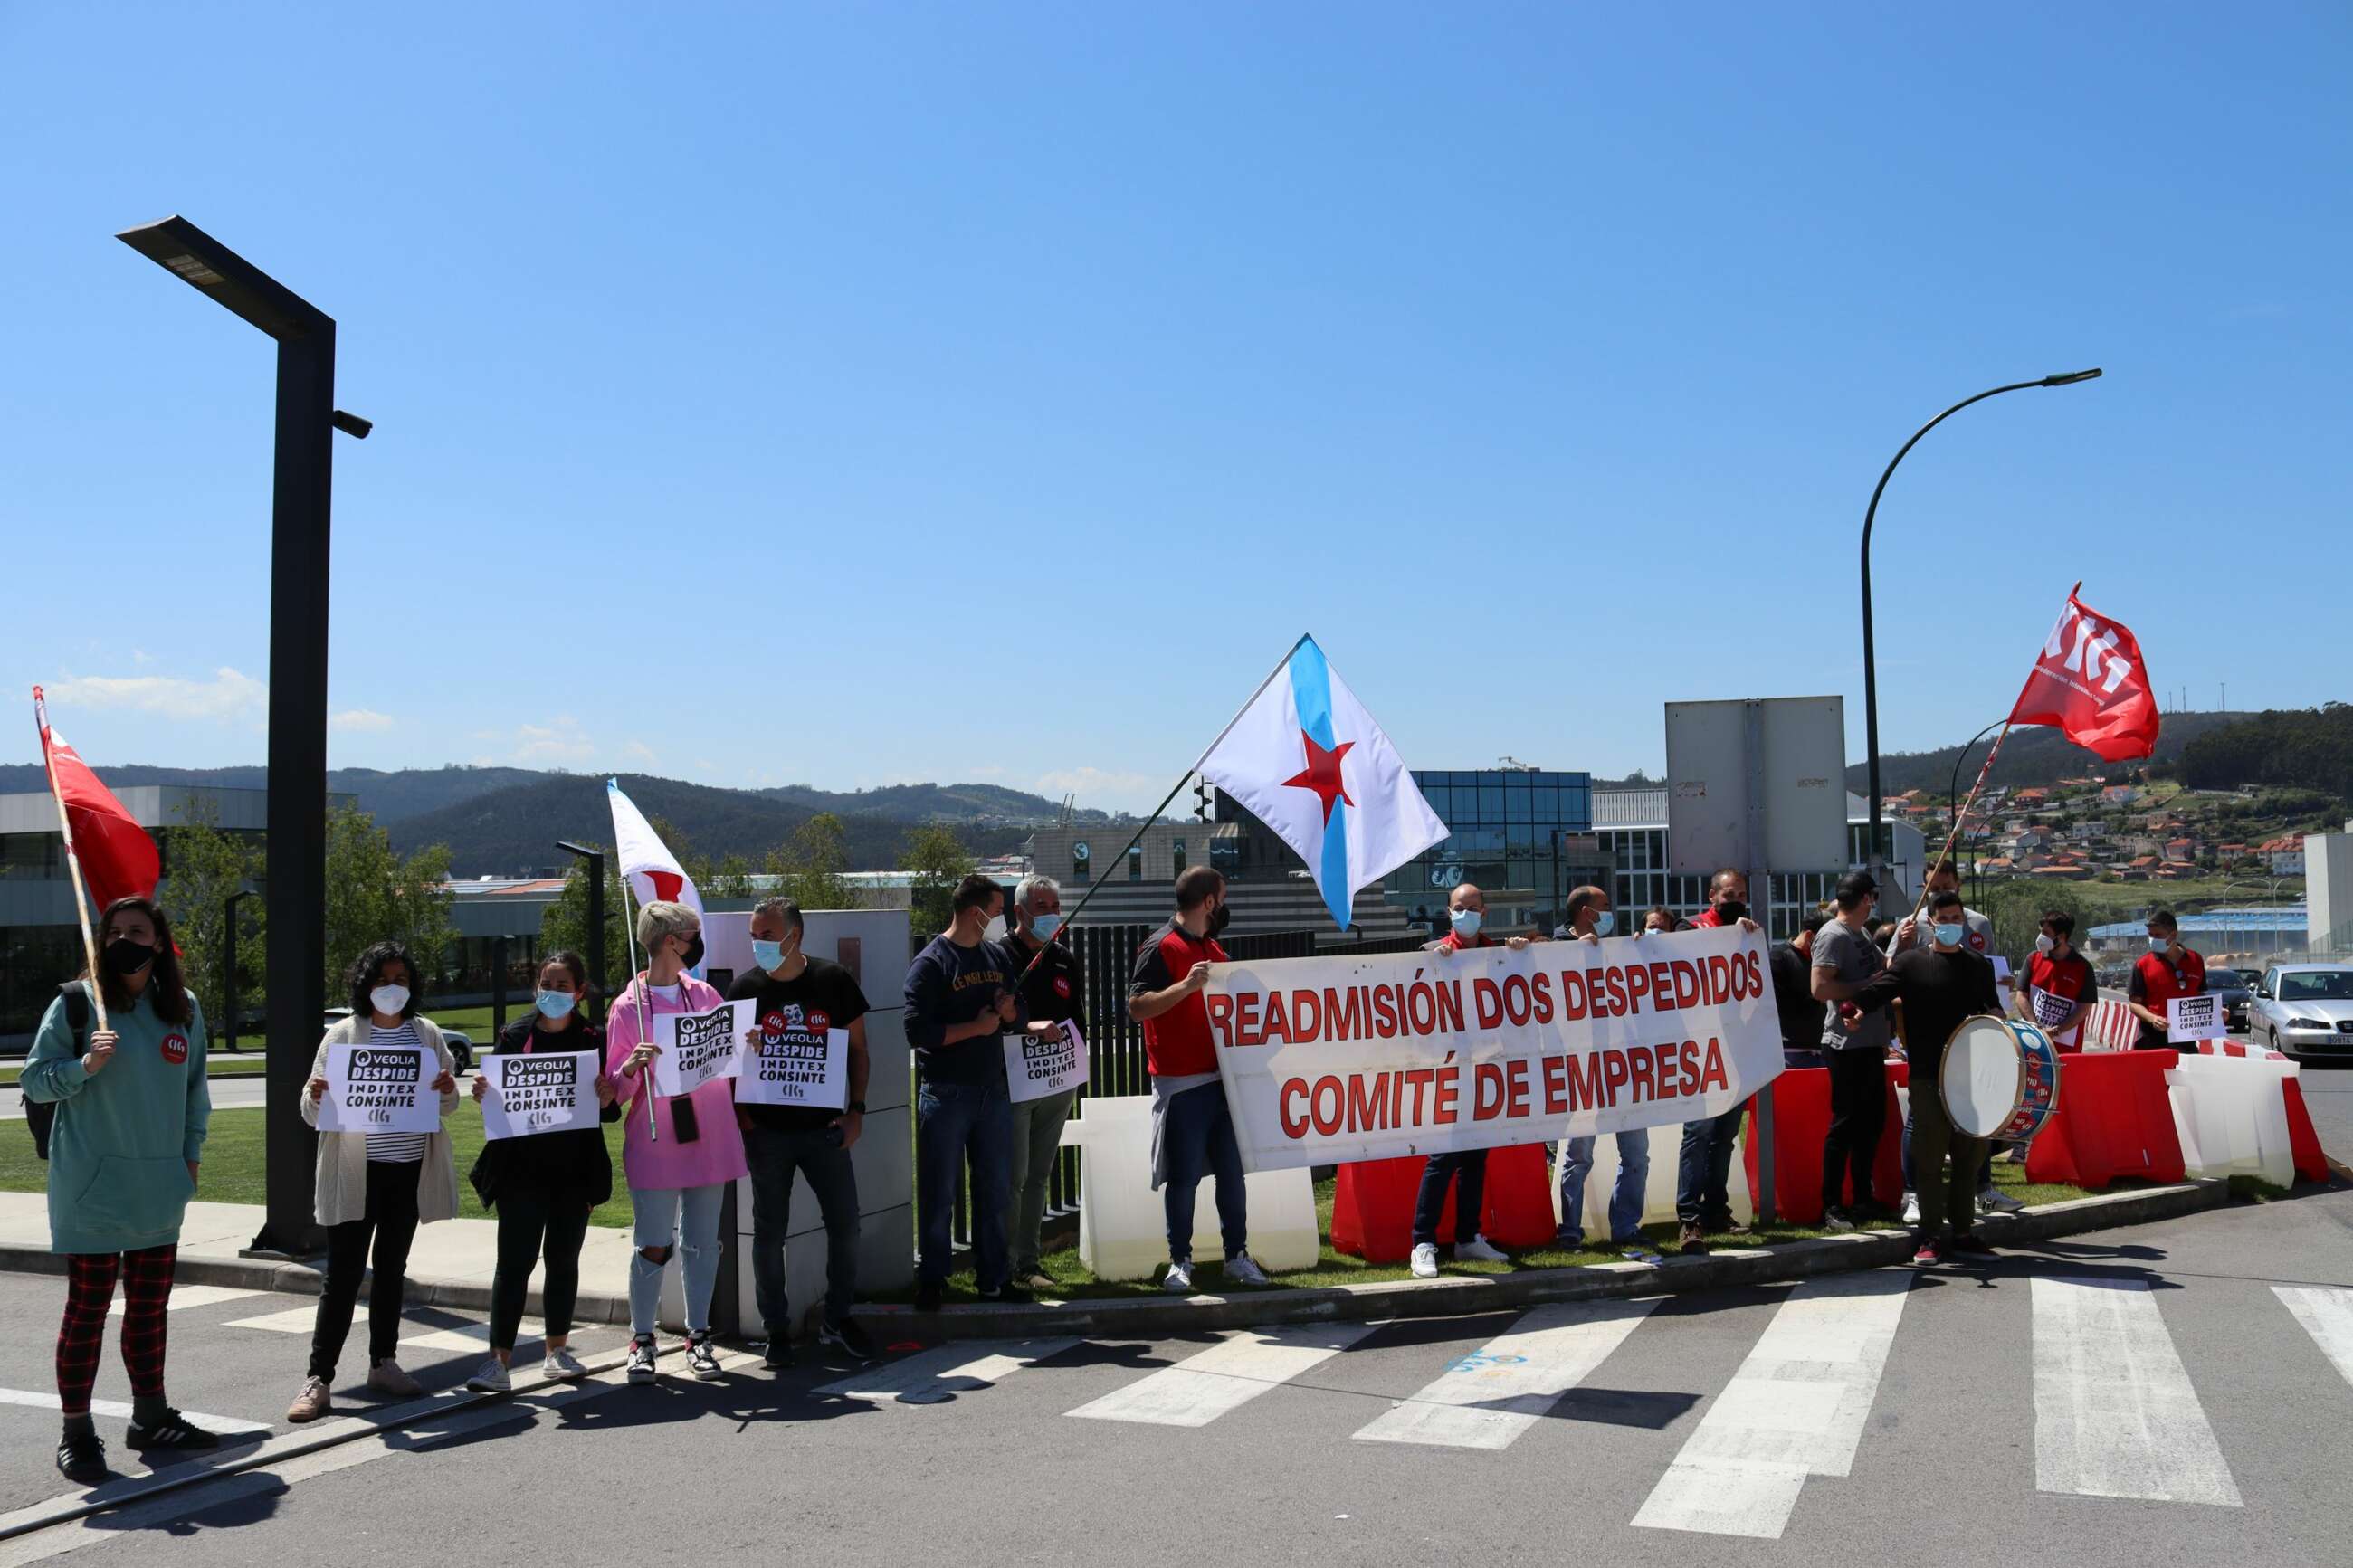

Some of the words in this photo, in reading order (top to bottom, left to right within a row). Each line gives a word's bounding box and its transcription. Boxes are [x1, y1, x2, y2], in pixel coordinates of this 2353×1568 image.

[1206, 968, 1465, 1048] READMISIÓN
[1473, 972, 1554, 1030] DOS
[1561, 949, 1763, 1022] DESPEDIDOS
[2036, 999, 2069, 1016] DESPIDE
[2180, 1006, 2212, 1016] DESPIDE
[698, 1010, 729, 1030] VEOLIA
[810, 1014, 826, 1024] CIG
[2179, 1014, 2213, 1022] INDITEX
[2179, 1021, 2213, 1030] CONSINTE
[680, 1021, 730, 1046] DESPIDE
[782, 1033, 824, 1044] VEOLIA
[679, 1034, 733, 1060] INDITEX
[762, 1045, 824, 1059] DESPIDE
[1025, 1038, 1073, 1058] DESPIDE
[374, 1054, 416, 1065] VEOLIA
[525, 1060, 572, 1071] VEOLIA
[678, 1045, 733, 1072] CONSINTE
[1026, 1050, 1076, 1069] INDITEX
[760, 1060, 826, 1072] INDITEX
[1027, 1060, 1077, 1080] CONSINTE
[351, 1067, 416, 1080] DESPIDE
[506, 1071, 573, 1088] DESPIDE
[759, 1070, 826, 1084] CONSINTE
[348, 1084, 416, 1094] INDITEX
[505, 1087, 576, 1099] INDITEX
[1280, 1050, 1459, 1139] COMITÉ
[1473, 1060, 1530, 1120] DE
[1542, 1037, 1729, 1116] EMPRESA
[346, 1096, 415, 1107] CONSINTE
[504, 1097, 576, 1113] CONSINTE
